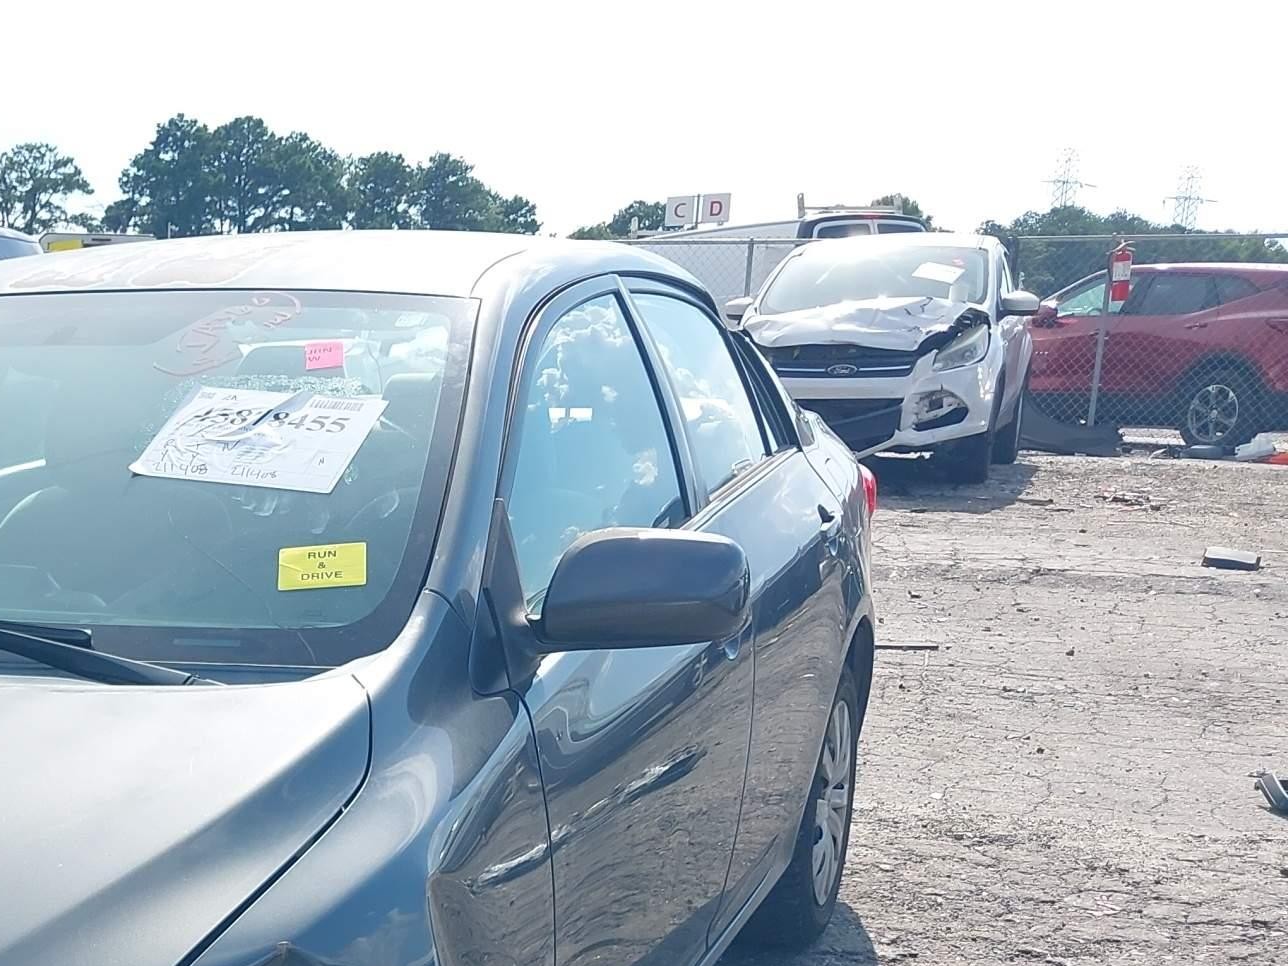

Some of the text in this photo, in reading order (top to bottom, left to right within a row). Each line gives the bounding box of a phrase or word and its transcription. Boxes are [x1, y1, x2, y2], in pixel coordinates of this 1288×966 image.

[674, 202, 687, 218] C
[709, 200, 723, 217] D
[307, 550, 337, 559] RUN
[317, 561, 326, 569] &
[301, 571, 343, 580] DRIVE
